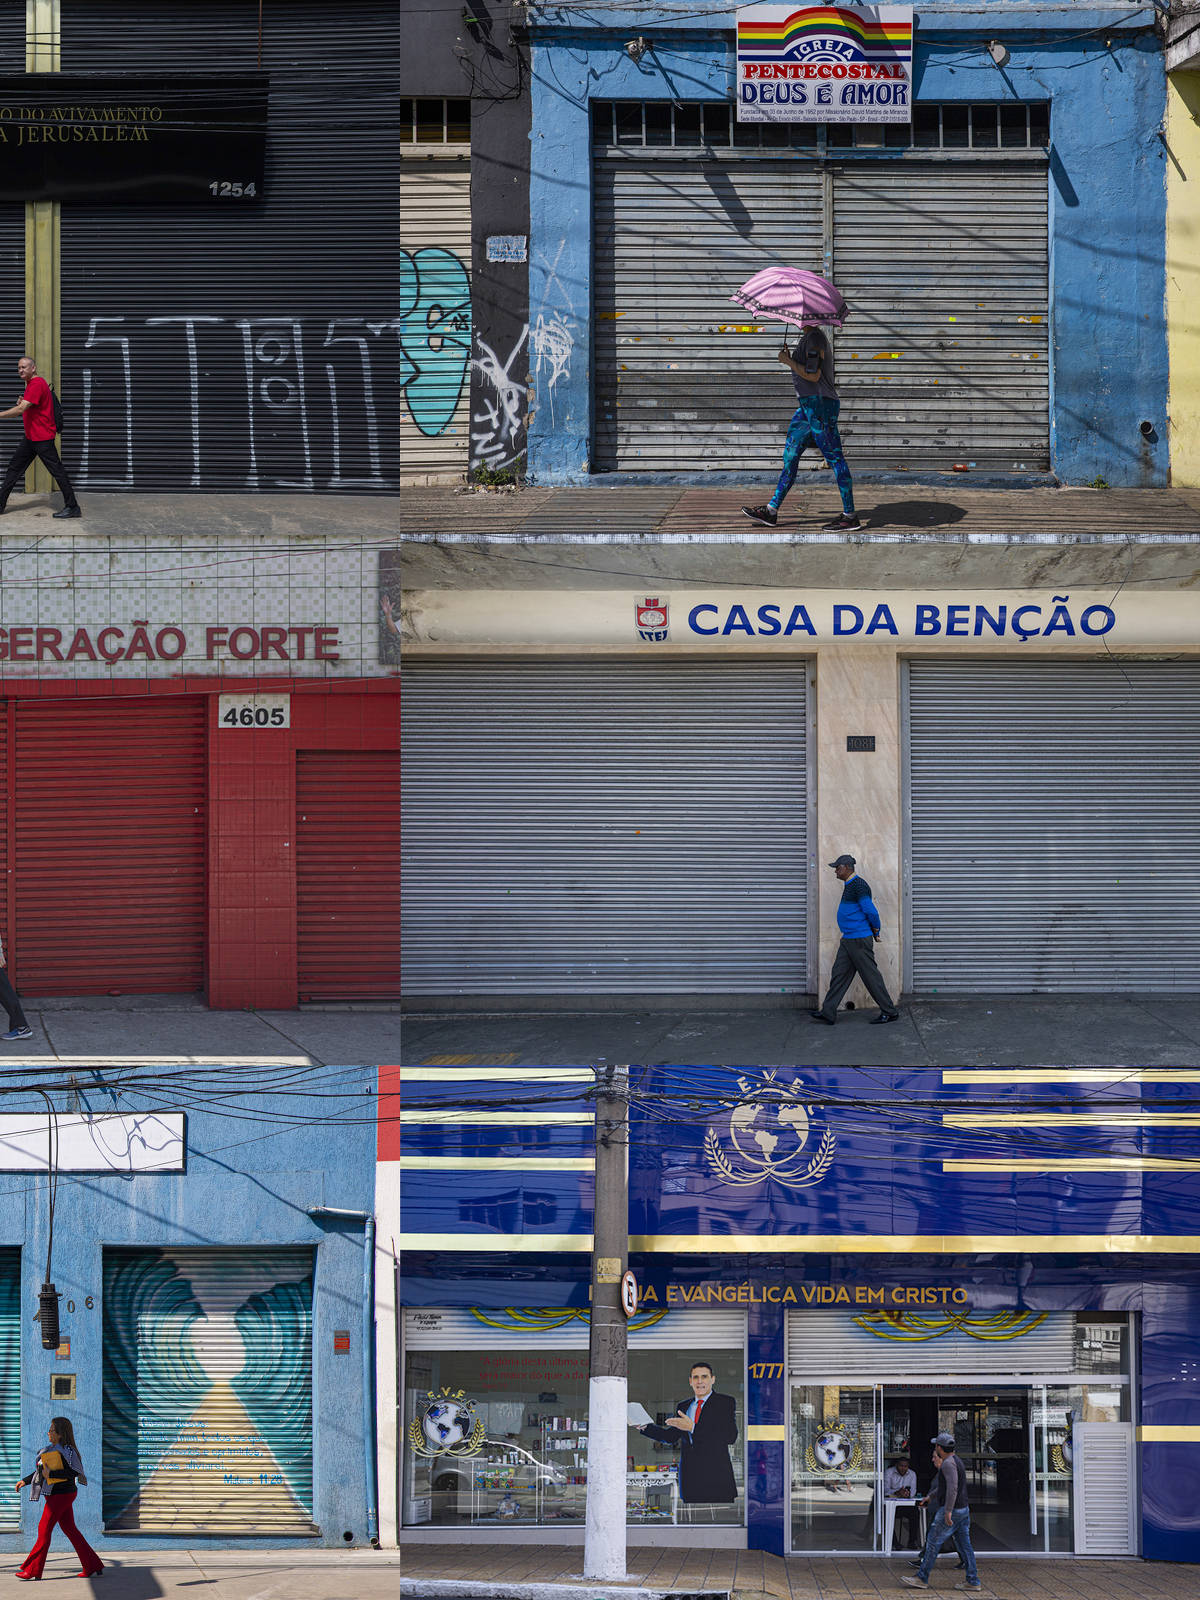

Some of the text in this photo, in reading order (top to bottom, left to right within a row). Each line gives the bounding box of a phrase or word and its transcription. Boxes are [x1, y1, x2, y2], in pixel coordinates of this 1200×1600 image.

[793, 39, 854, 61] IGREJA
[742, 63, 908, 80] PENTECOSTAL
[740, 82, 908, 106] DEUS É AMOR
[20, 107, 45, 122] DO
[50, 106, 163, 122] AVIVAMENTO
[17, 125, 150, 146] JERUSALEM
[209, 181, 257, 198] 1254
[688, 595, 1117, 642] CASA DA BENÇÃO
[205, 626, 340, 661] FORTE
[223, 707, 285, 727] 4605
[588, 1281, 968, 1304] IJA EVANGÉLICA VIDA EM CRISTO
